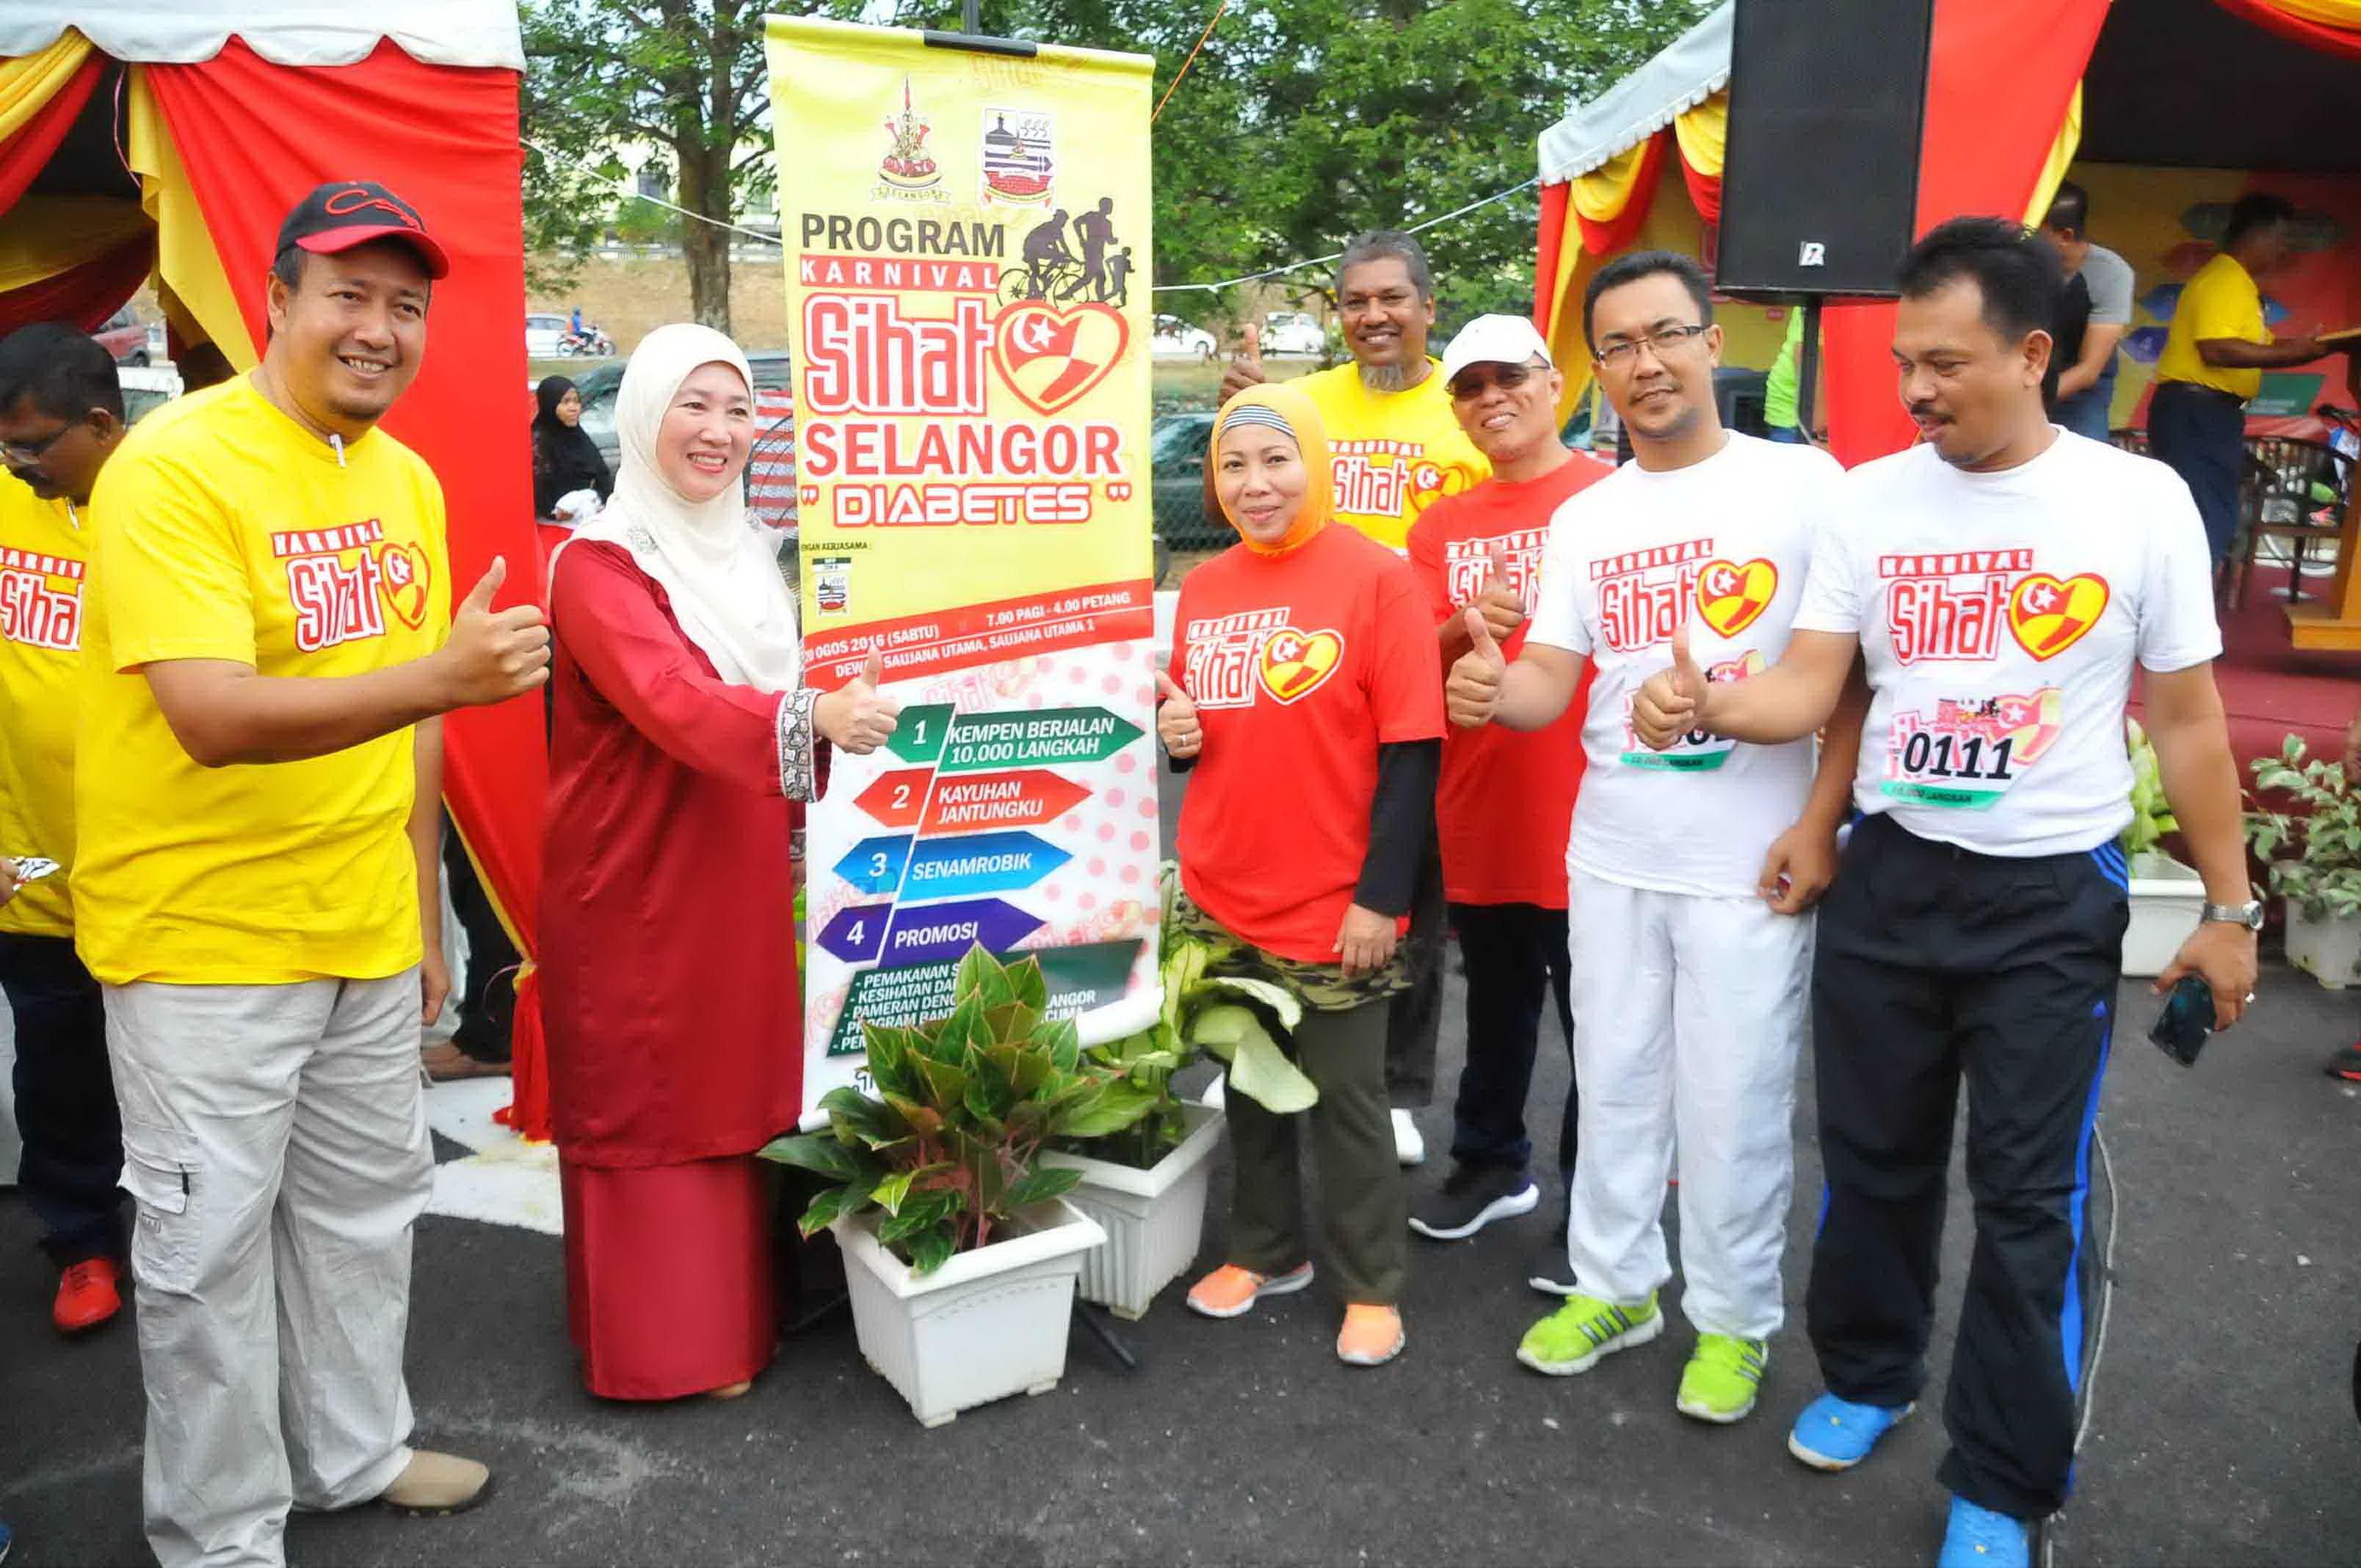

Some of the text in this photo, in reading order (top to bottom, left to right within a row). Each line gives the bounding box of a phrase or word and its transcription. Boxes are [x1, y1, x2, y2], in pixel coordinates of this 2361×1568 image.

[801, 213, 1004, 257] PROGRAM
[801, 258, 998, 289] KARNIVAL
[803, 292, 995, 417] Sihat
[805, 423, 1121, 476] SELANGOR
[1332, 456, 1410, 518] Sihat
[834, 482, 1092, 528] DIABETES
[1881, 550, 2032, 576] KARNIVAL
[987, 611, 1014, 627] 7.00
[1016, 606, 1045, 624] PAGI
[1053, 598, 1080, 614] 4.00
[1082, 591, 1131, 610] PETANG
[1599, 562, 1697, 653] Sihat
[1887, 573, 2016, 667] Sihat
[816, 639, 849, 659] OGOS
[850, 633, 885, 650] 2016
[887, 624, 940, 647] (SABTU)
[883, 647, 940, 669] SAUJANA
[941, 637, 987, 658] UTAMA,
[989, 629, 1042, 649] SAUJANA
[1043, 622, 1084, 639] UTAMA
[1086, 619, 1095, 631] 1
[913, 719, 927, 745] 1
[949, 717, 1115, 744] KEMPEN BERJALAN
[951, 737, 1100, 765] 10,000 LANGKAH
[1903, 732, 2014, 780] 0111
[891, 784, 911, 810] 2
[938, 780, 1023, 805] KAYUHAN
[937, 799, 1043, 825] JANTUNGKU
[868, 852, 888, 878] 3
[912, 852, 1034, 881] SENAMROBIK
[846, 920, 866, 945] 4
[894, 921, 979, 949] PROMOSI
[863, 964, 951, 989] PEMAKANAN
[858, 981, 932, 1004] KESIHATAN
[1045, 990, 1097, 1010] ANGOR
[852, 998, 919, 1019] PAMERAN
